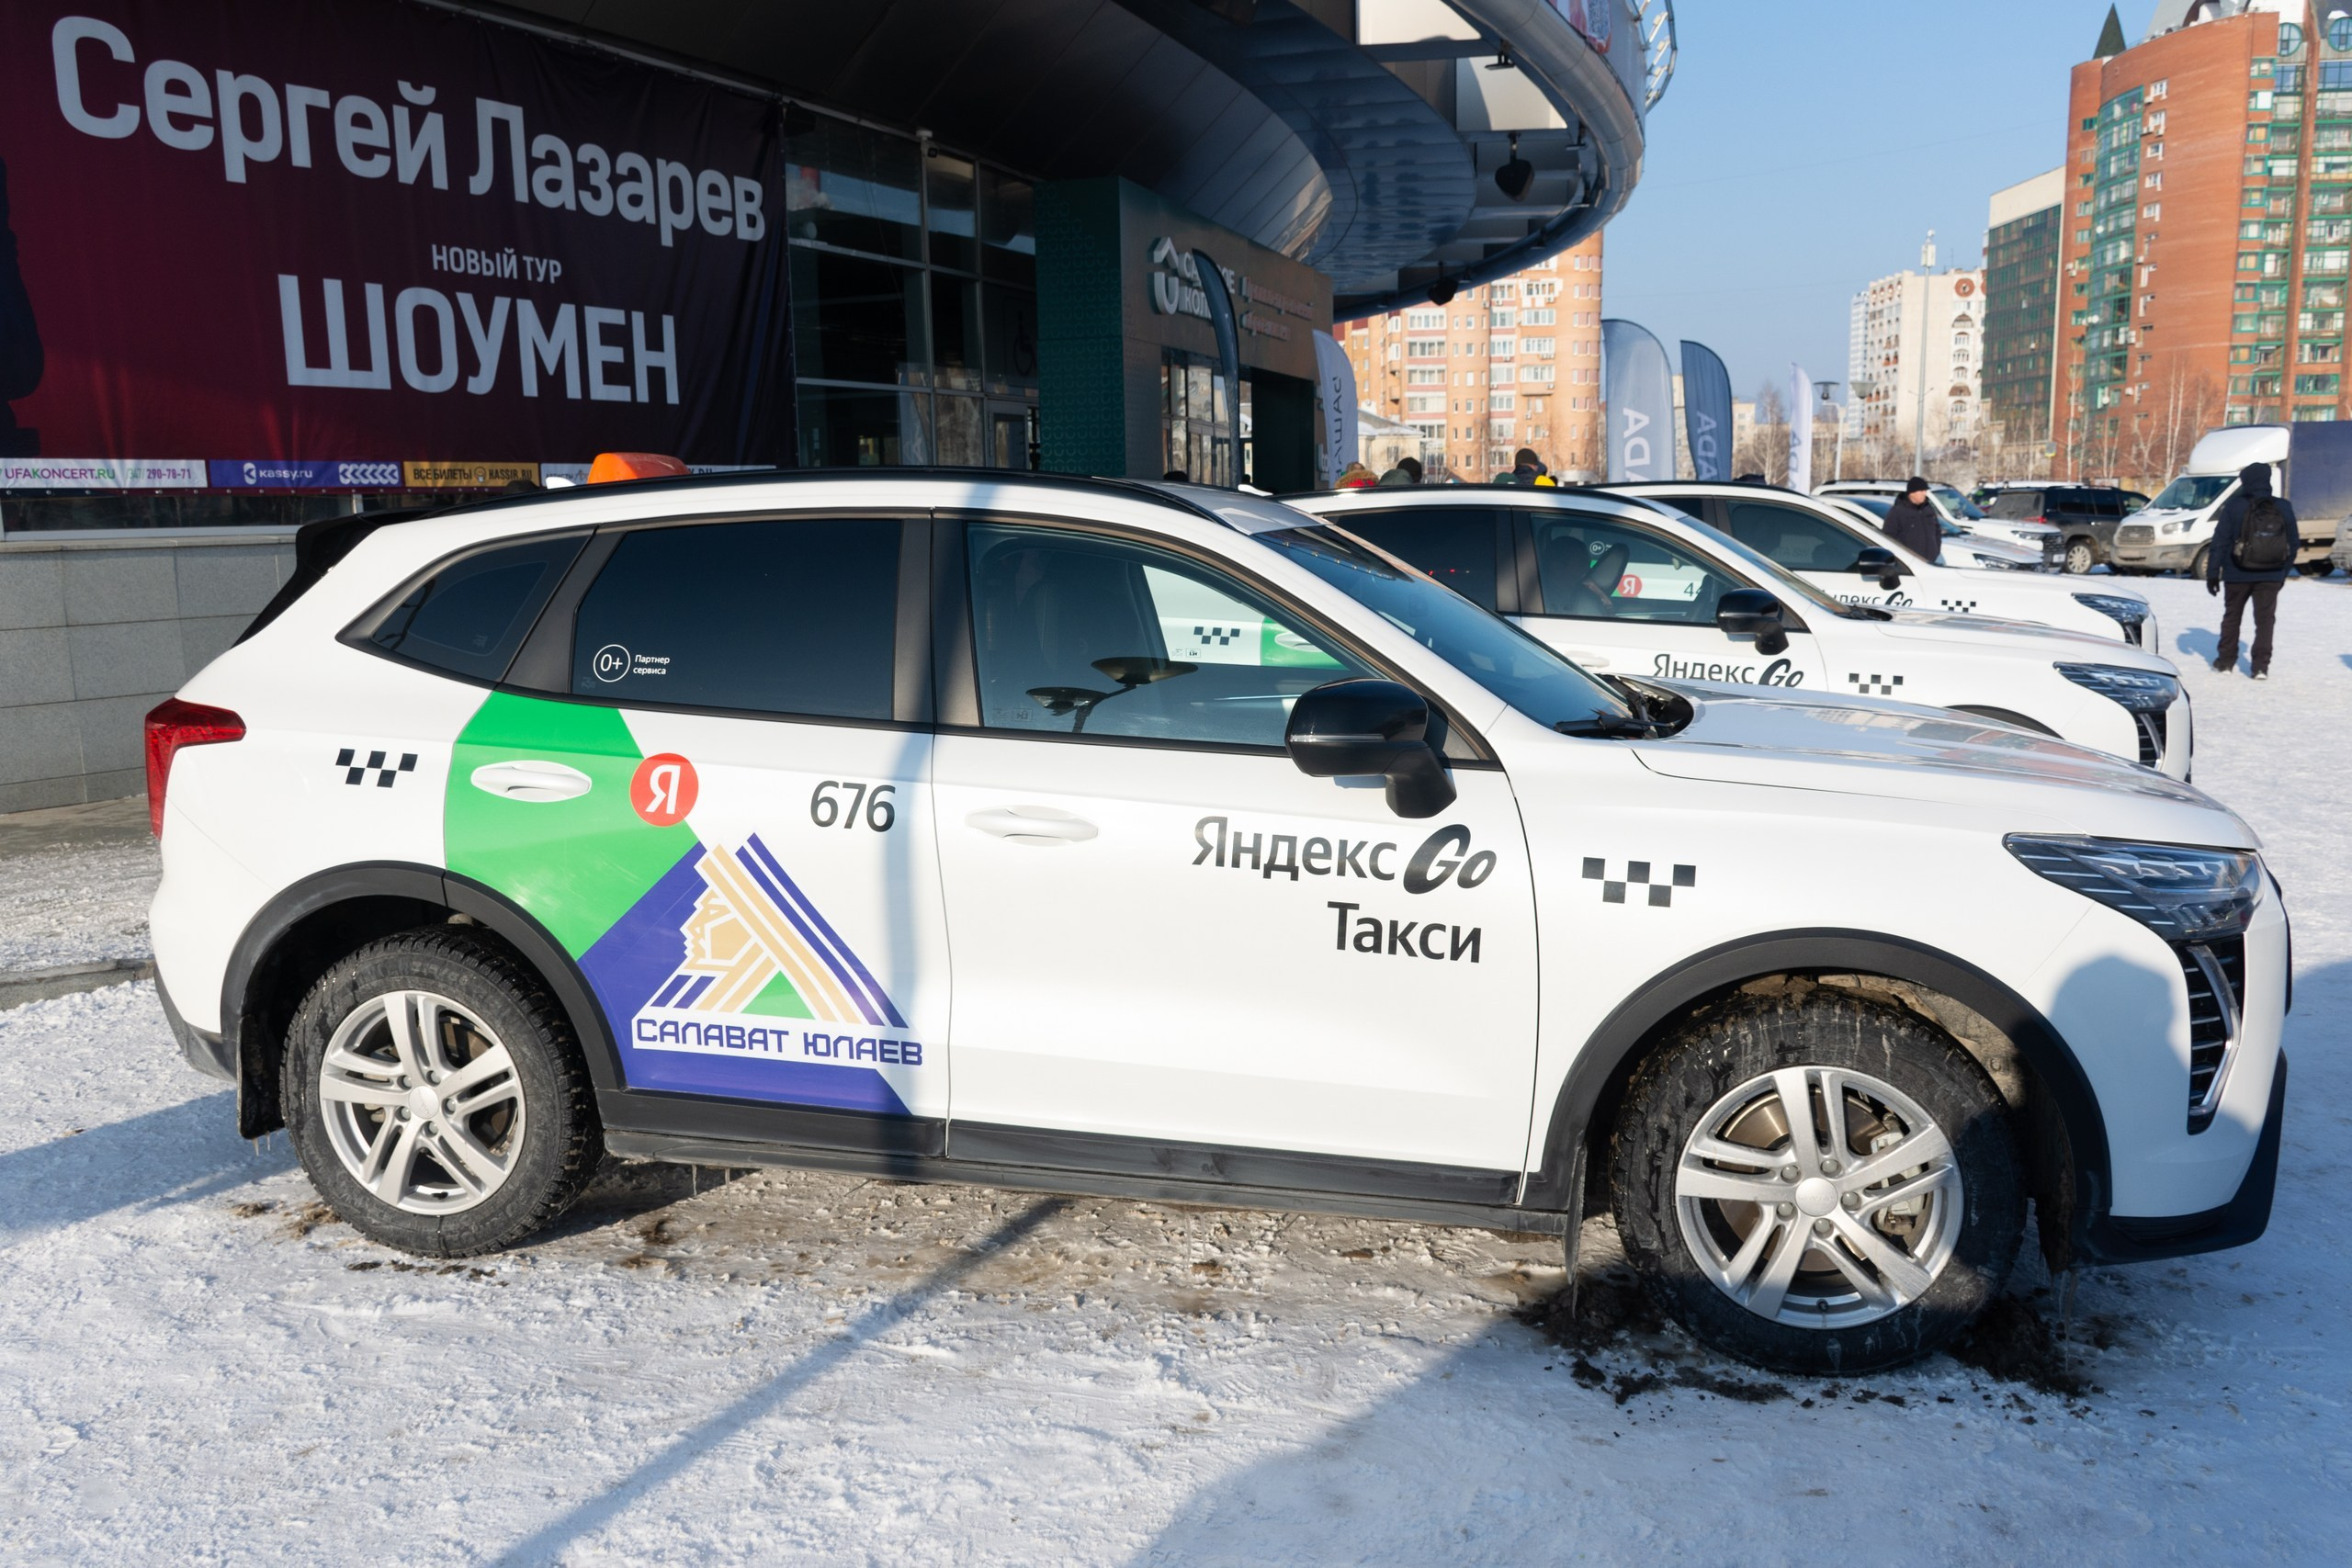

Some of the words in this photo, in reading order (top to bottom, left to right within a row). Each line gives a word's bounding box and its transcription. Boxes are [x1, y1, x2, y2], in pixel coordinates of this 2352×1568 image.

[51, 16, 448, 191] Сергей
[469, 96, 767, 248] Лазарев
[431, 243, 517, 281] НОВЫЙ
[523, 255, 562, 285] ТУР
[278, 273, 680, 405] ШОУМЕН
[5, 468, 116, 479] UFAKONCERT.RU
[147, 468, 191, 479] 290-78-71
[413, 469, 432, 480] ВСЕ
[434, 469, 471, 480] БИЛЕТЫ
[600, 653, 624, 672] 0+
[633, 666, 667, 676] сервиса
[635, 654, 671, 665] Партнер
[1654, 653, 1756, 684] Яндекс
[1758, 658, 1804, 688] Go
[645, 764, 682, 815] Я
[810, 780, 897, 832] 676
[1192, 815, 1397, 882] Яндекс
[1403, 823, 1498, 895] Go
[1327, 900, 1482, 964] Такси
[637, 1019, 788, 1054] САЛАВАТ
[803, 1032, 923, 1066] ЮЛАЕВ
